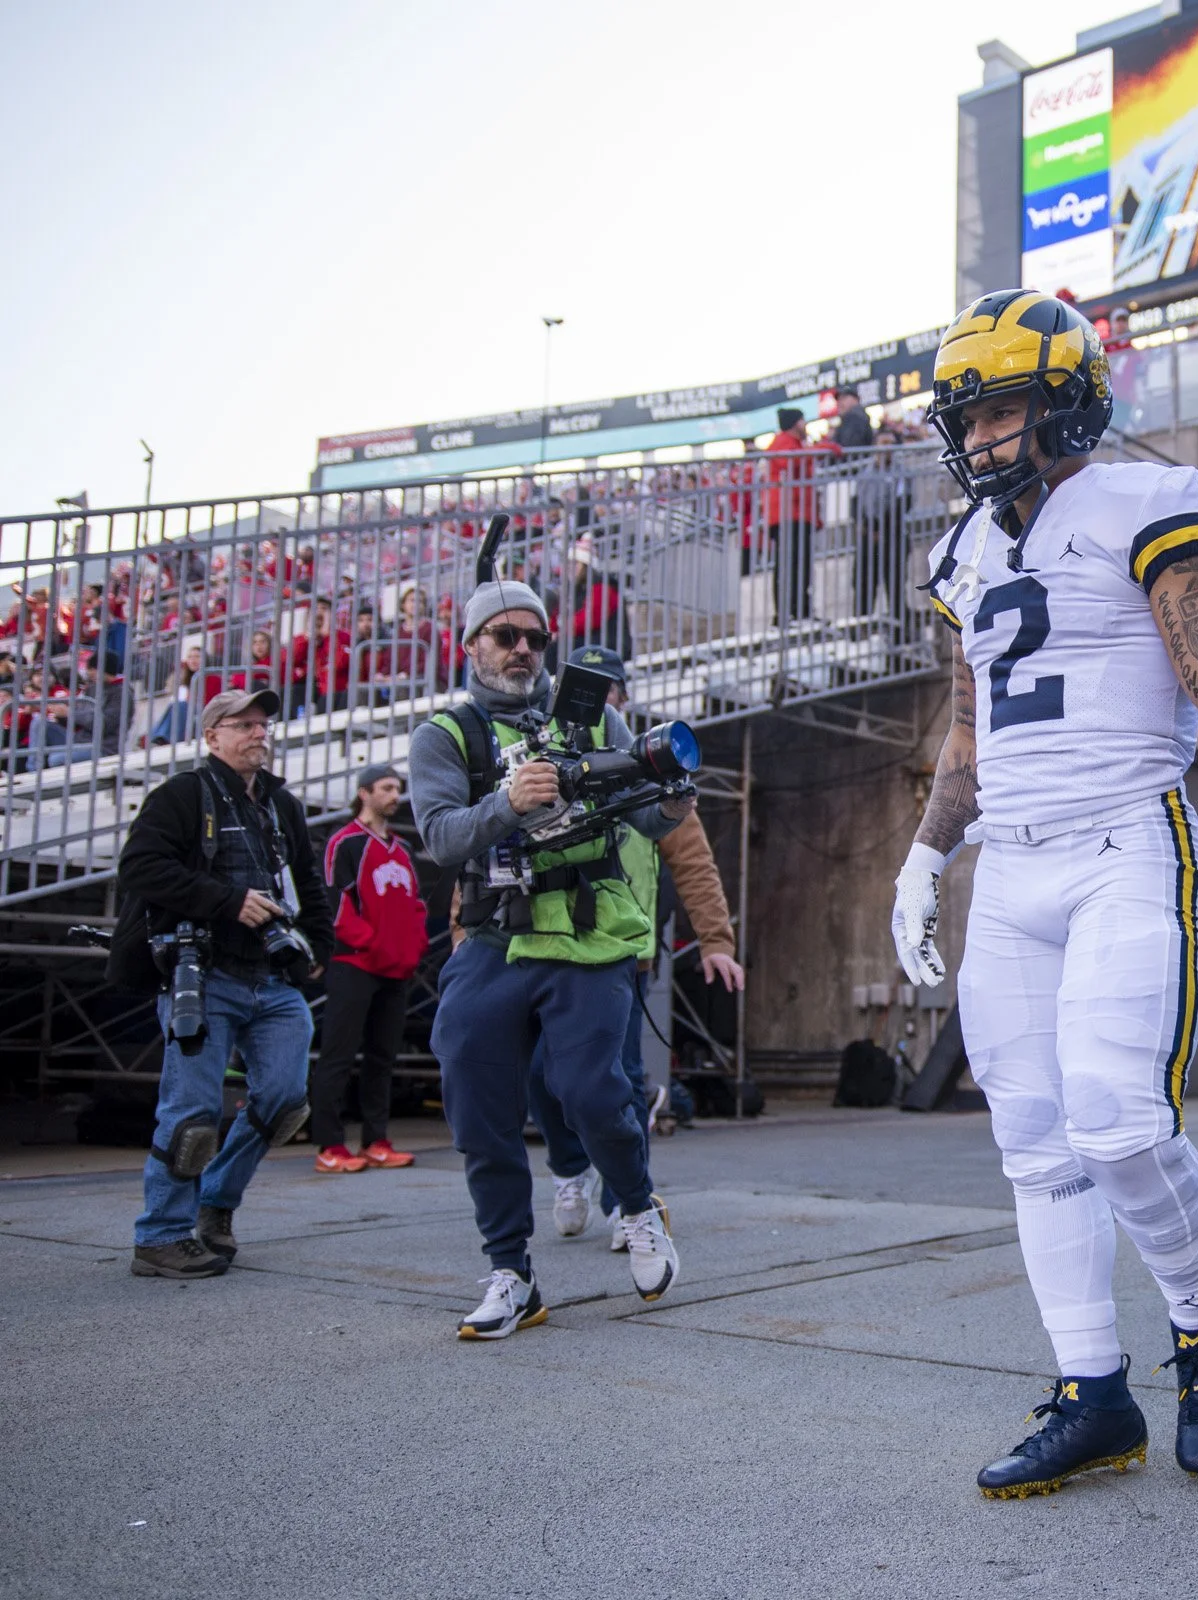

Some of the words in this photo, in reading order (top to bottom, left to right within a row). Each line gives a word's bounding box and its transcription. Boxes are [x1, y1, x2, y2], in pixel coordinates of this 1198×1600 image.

[949, 376, 963, 391] M
[973, 575, 1064, 733] 2
[1061, 1382, 1080, 1401] M
